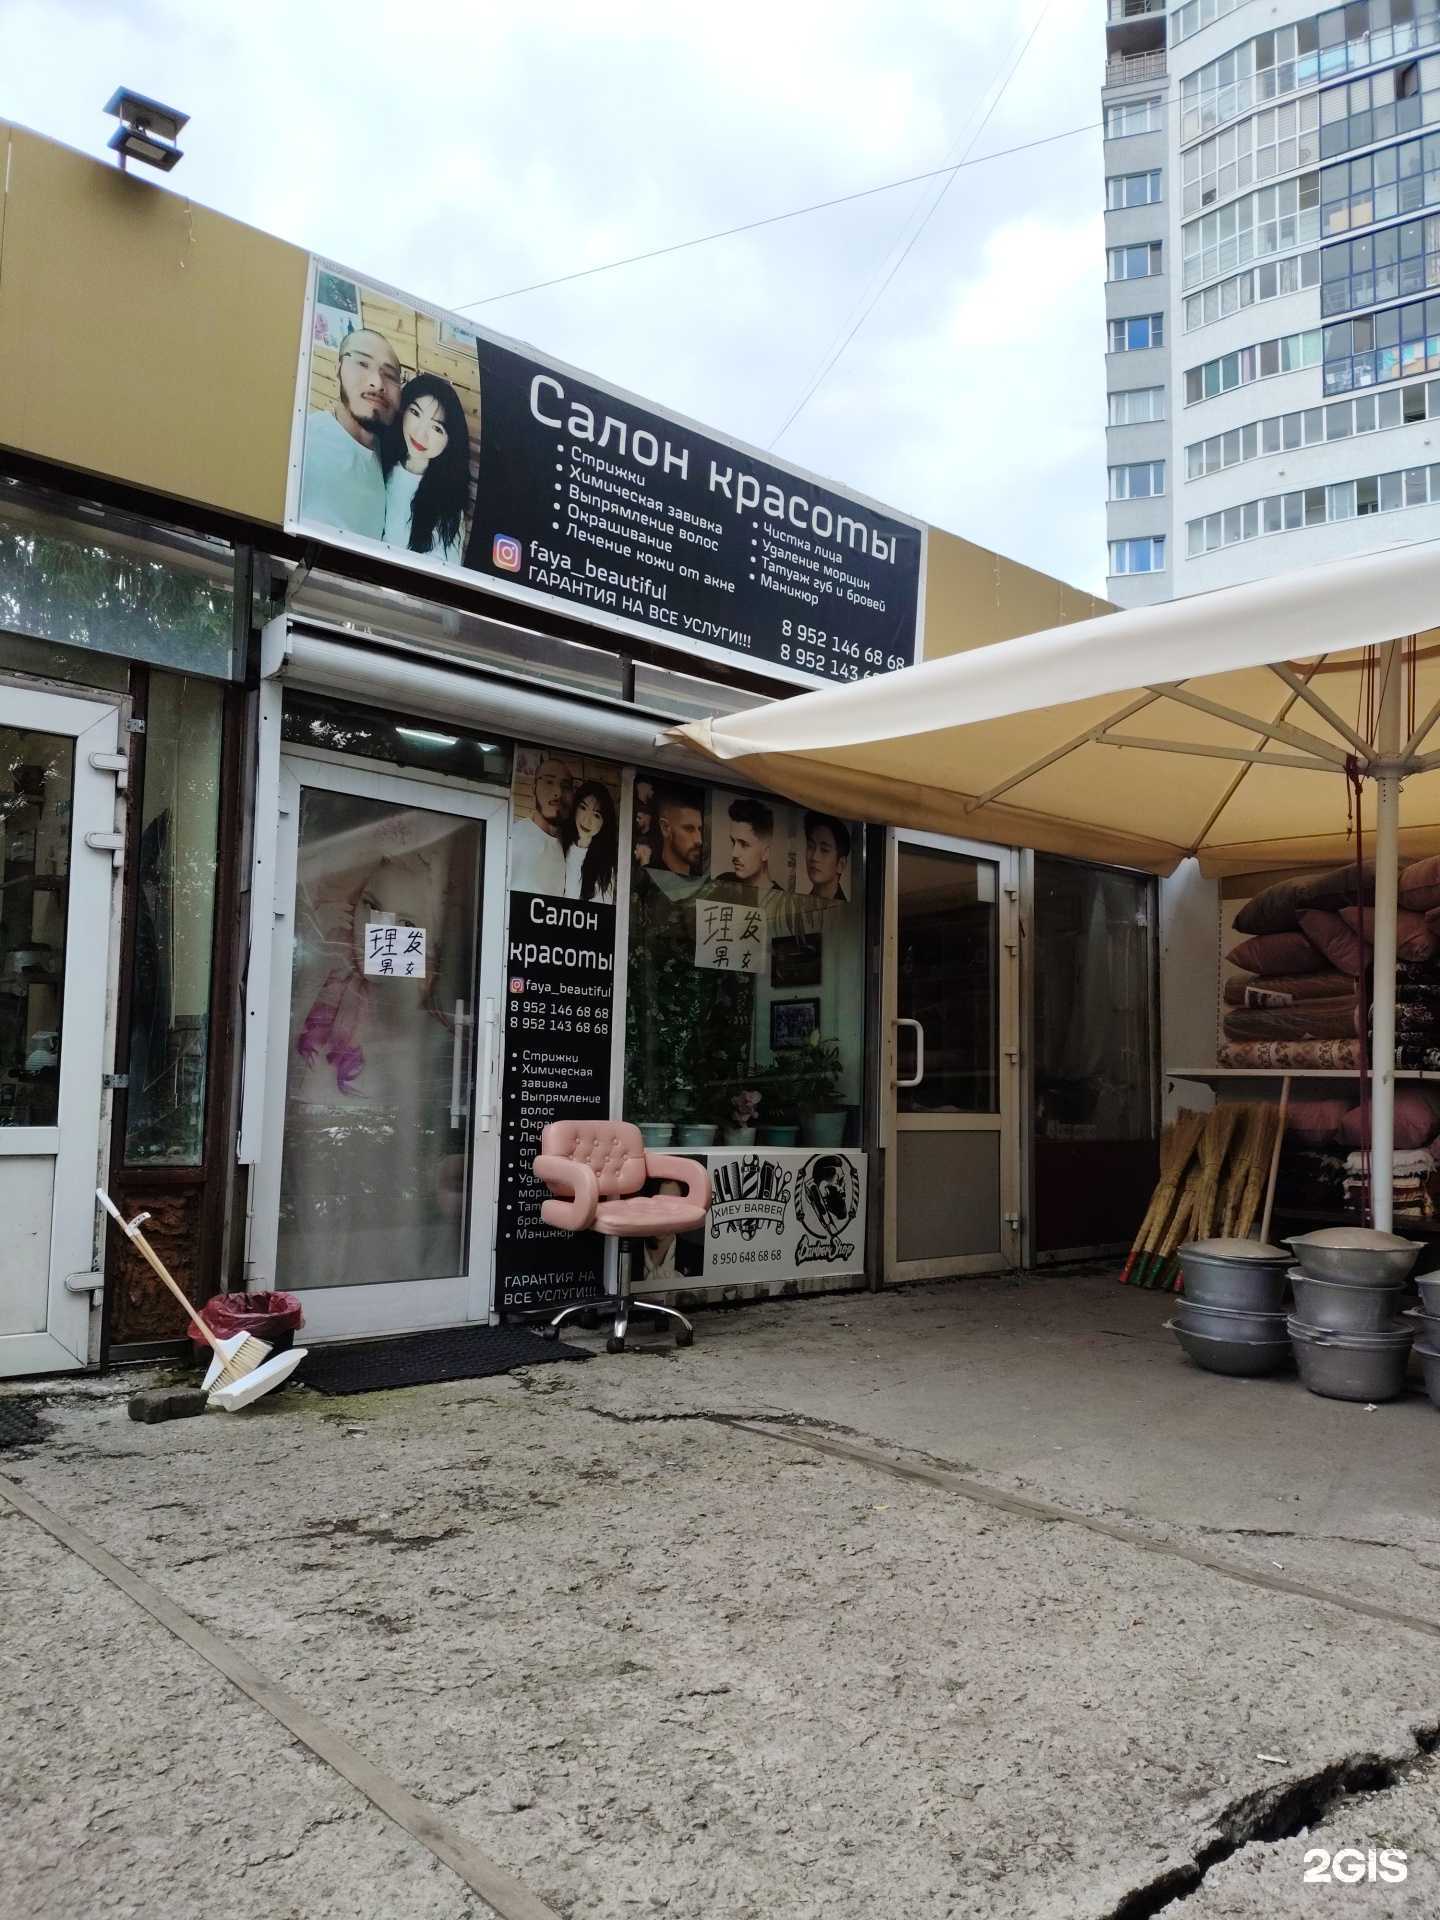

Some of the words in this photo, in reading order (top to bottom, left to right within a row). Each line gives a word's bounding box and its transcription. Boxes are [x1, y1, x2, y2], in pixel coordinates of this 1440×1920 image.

[530, 374, 689, 480] Салон
[709, 460, 896, 564] красоты
[571, 446, 645, 486] Стрижки
[569, 464, 663, 512] Химическая
[667, 505, 723, 535] завивка
[567, 503, 673, 552] Окрашивание
[569, 484, 674, 535] Выпрямление
[679, 528, 719, 551] волос
[566, 523, 632, 557] Лечение
[637, 551, 674, 572] кожи
[679, 565, 700, 581] от
[704, 573, 736, 592] акне
[764, 522, 811, 551] Чистка
[814, 545, 843, 564] лица
[529, 541, 667, 600] faya_beautiful
[762, 539, 819, 572] Удаление
[823, 564, 870, 590] морщин
[760, 573, 819, 606] Маникюр
[762, 556, 810, 585] Татуаж
[813, 577, 833, 594] губ
[836, 588, 843, 597] и
[846, 588, 886, 612] бровей
[528, 566, 616, 607] ГАРАНТИЯ
[622, 596, 644, 615] НА
[649, 605, 678, 625] ВСЕ
[683, 615, 751, 648] УСЛУГИ!!!
[782, 619, 792, 636] 8
[797, 625, 827, 648] 952
[831, 636, 860, 658] 146
[864, 647, 883, 665] 68
[887, 654, 905, 670] 68
[780, 643, 790, 660] 8
[796, 649, 825, 671] 952
[830, 660, 858, 680] 143
[530, 898, 598, 931] Салон
[703, 906, 762, 945] 理发
[369, 928, 424, 959] 理发
[510, 942, 613, 971] красоты
[525, 979, 612, 998] faya_beautiful
[510, 1000, 519, 1012] 8
[522, 1001, 546, 1014] 952
[550, 1003, 573, 1016] 146
[576, 1006, 591, 1018] 68
[594, 1007, 609, 1019] 68
[510, 1016, 518, 1028] 8
[522, 1018, 546, 1030] 952
[550, 1019, 572, 1032] 143
[575, 1022, 590, 1033] 68
[593, 1023, 608, 1034] 68
[522, 1050, 579, 1064] Стрижки
[522, 1064, 593, 1077] Химическая
[521, 1079, 568, 1089] завивка
[521, 1091, 601, 1104] Выпрямление
[520, 1106, 555, 1115] волос
[520, 1148, 537, 1156] от
[744, 1203, 783, 1215] BARBER
[712, 1254, 718, 1265] 8
[720, 1252, 737, 1264] 950
[739, 1251, 756, 1263] 648
[758, 1250, 769, 1262] 68
[771, 1250, 782, 1261] 68
[504, 1272, 574, 1288] ГАРАНТИЯ
[578, 1270, 596, 1282] НА
[504, 1291, 532, 1305] ВСЕ
